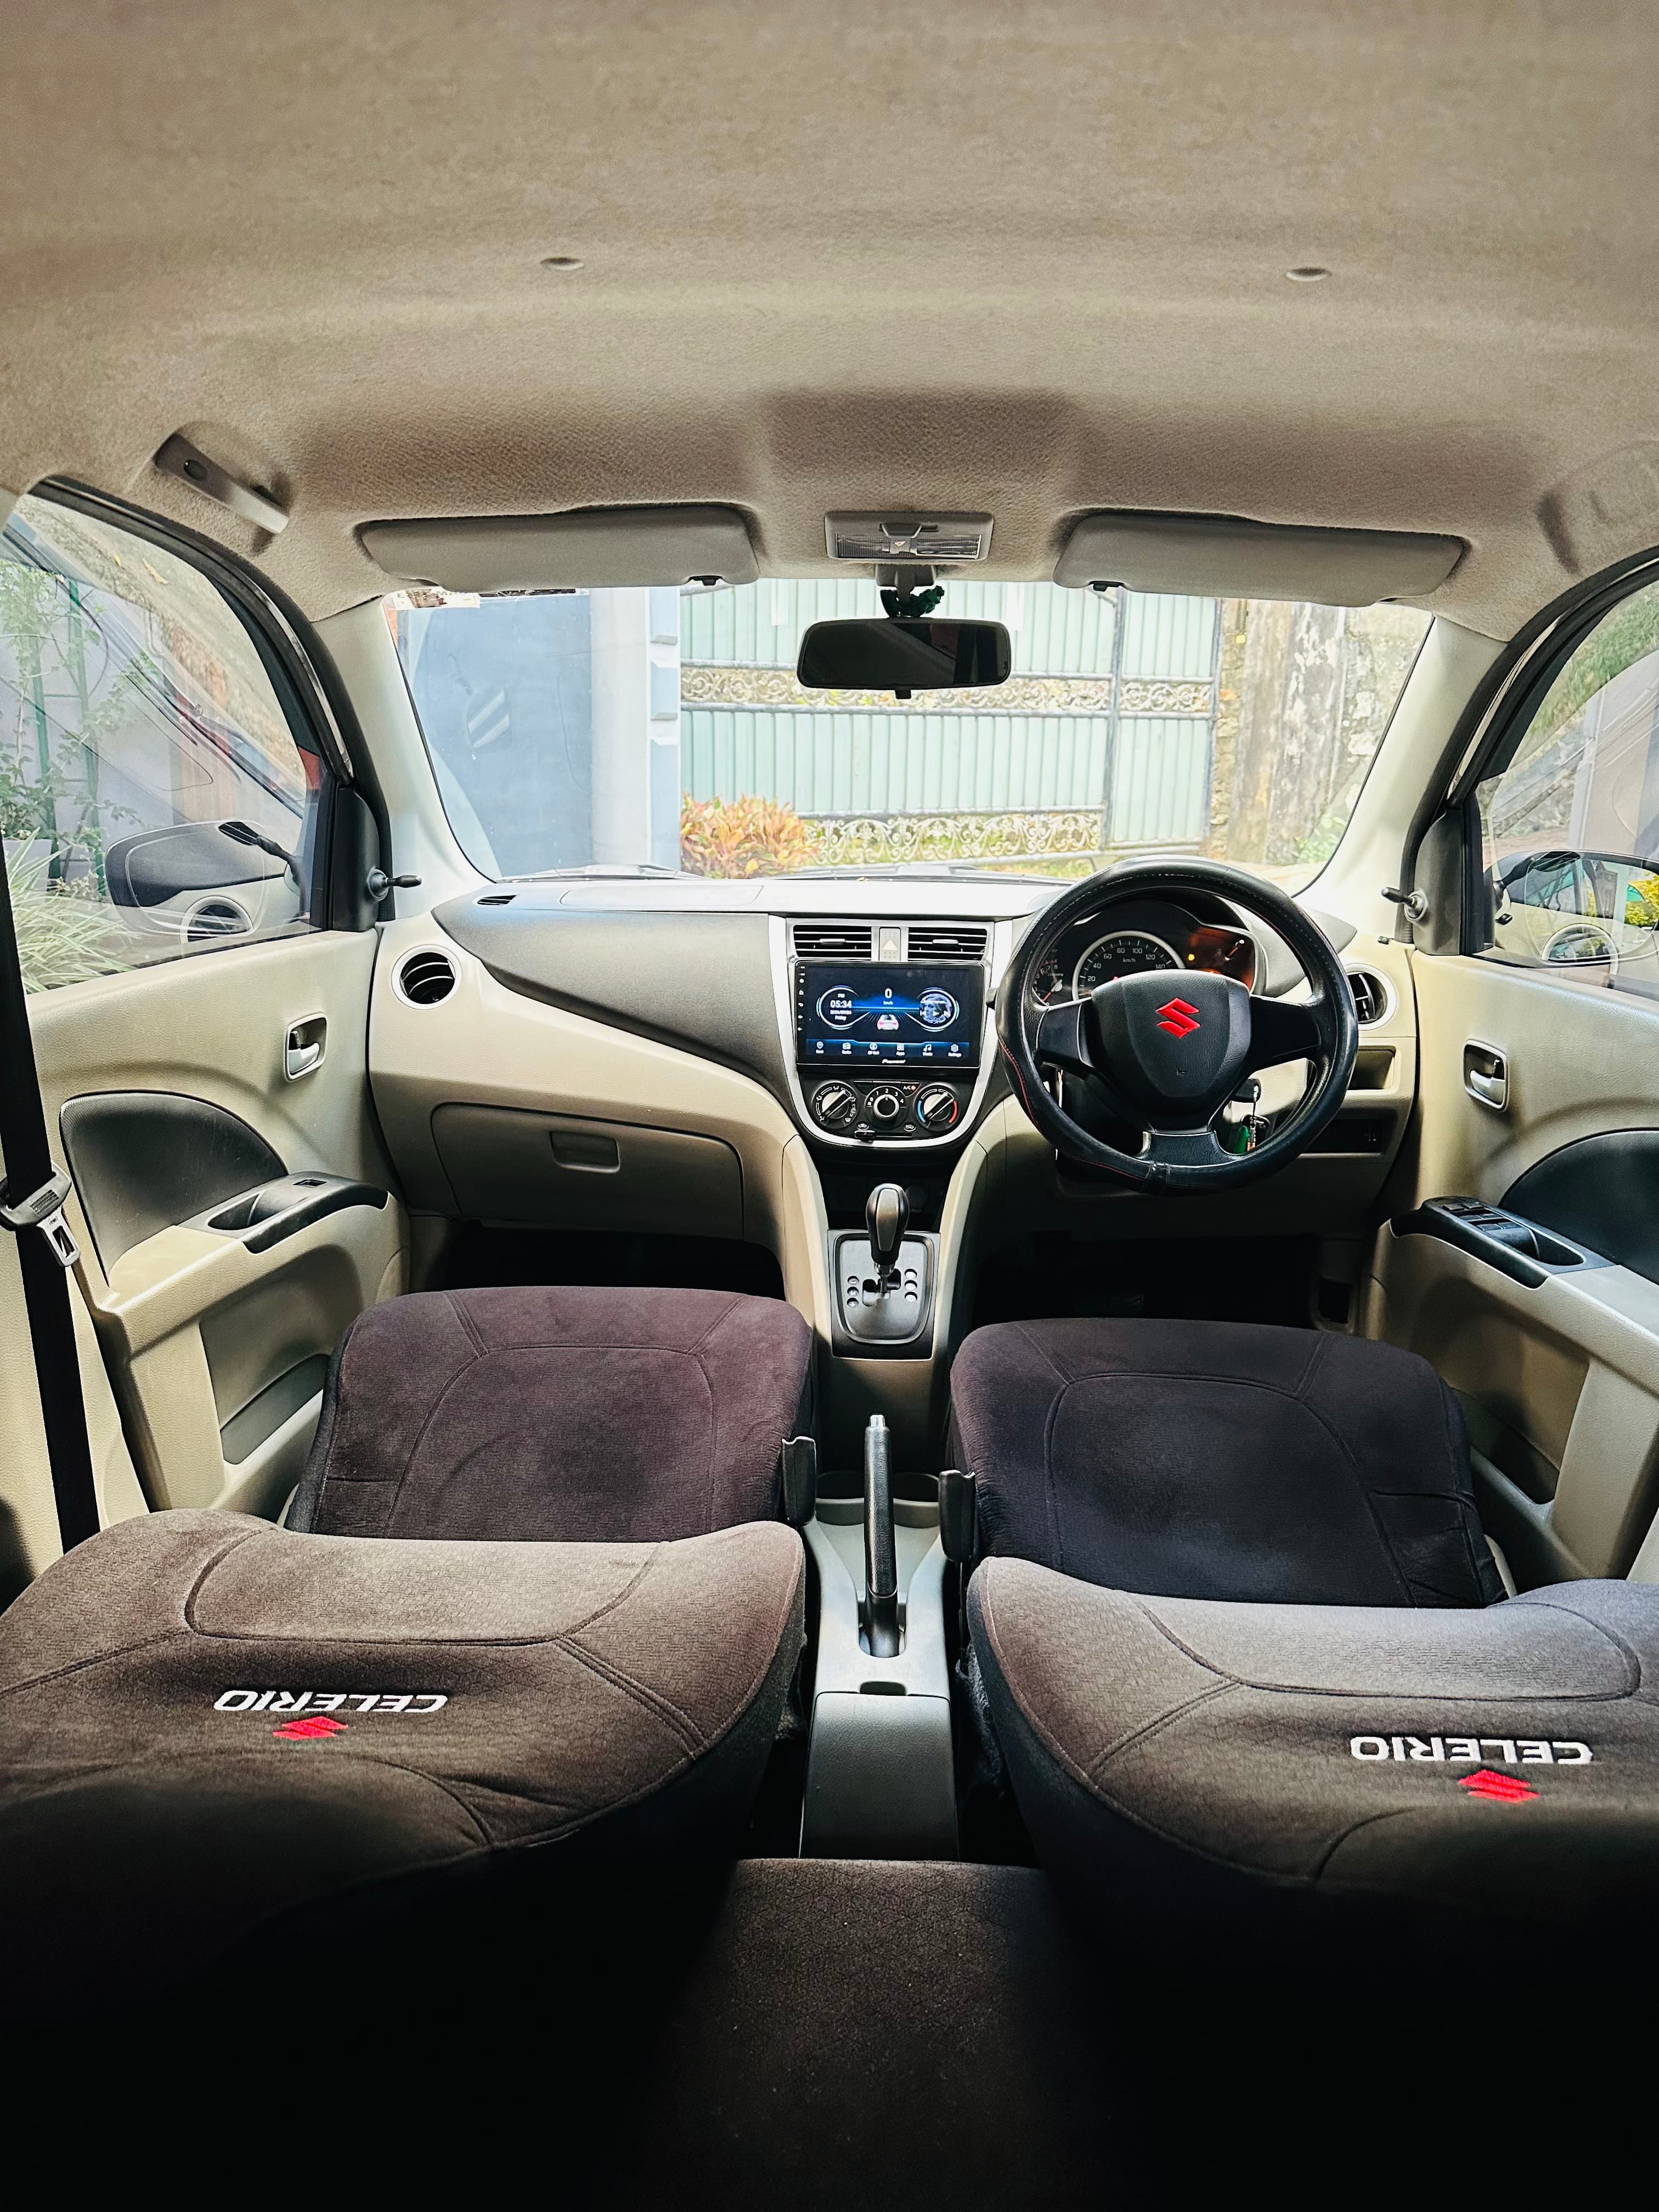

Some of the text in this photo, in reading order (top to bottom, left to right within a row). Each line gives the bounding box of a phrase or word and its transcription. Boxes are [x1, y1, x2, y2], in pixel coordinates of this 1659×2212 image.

[884, 988, 892, 998] 0
[830, 1000, 852, 1008] 05:34
[214, 1690, 448, 1713] CELERIO
[1350, 1736, 1593, 1765] CELERIO
